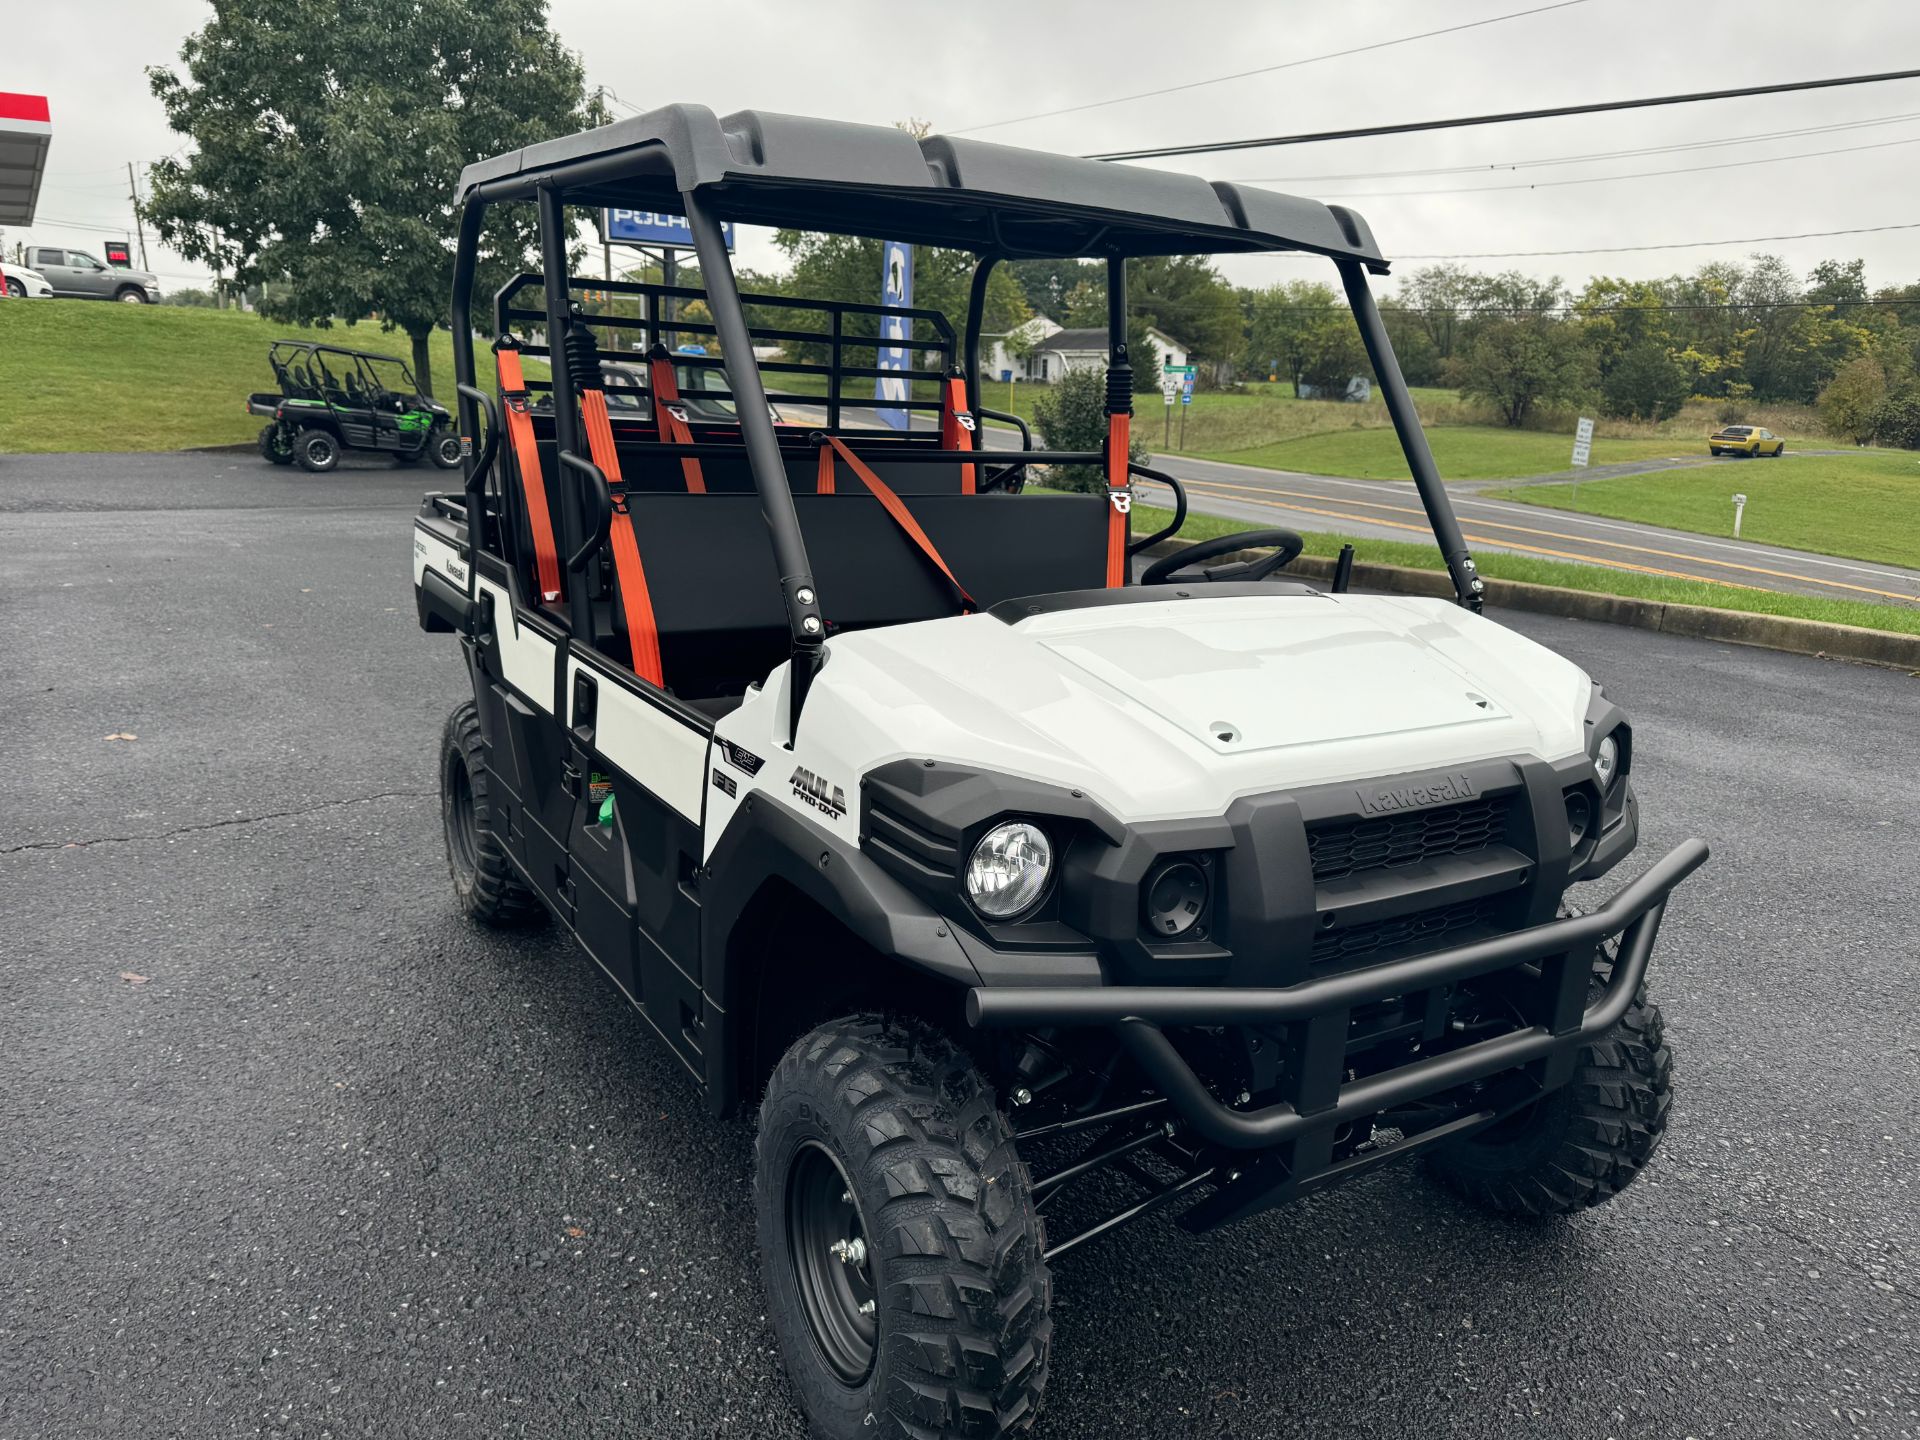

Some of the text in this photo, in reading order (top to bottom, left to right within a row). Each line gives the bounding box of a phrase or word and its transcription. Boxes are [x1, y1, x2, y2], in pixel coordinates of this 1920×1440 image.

[713, 770, 737, 797] FE
[789, 765, 847, 816] MULE
[1355, 774, 1477, 814] Kawasaki
[793, 786, 841, 821] PRO-DXT
